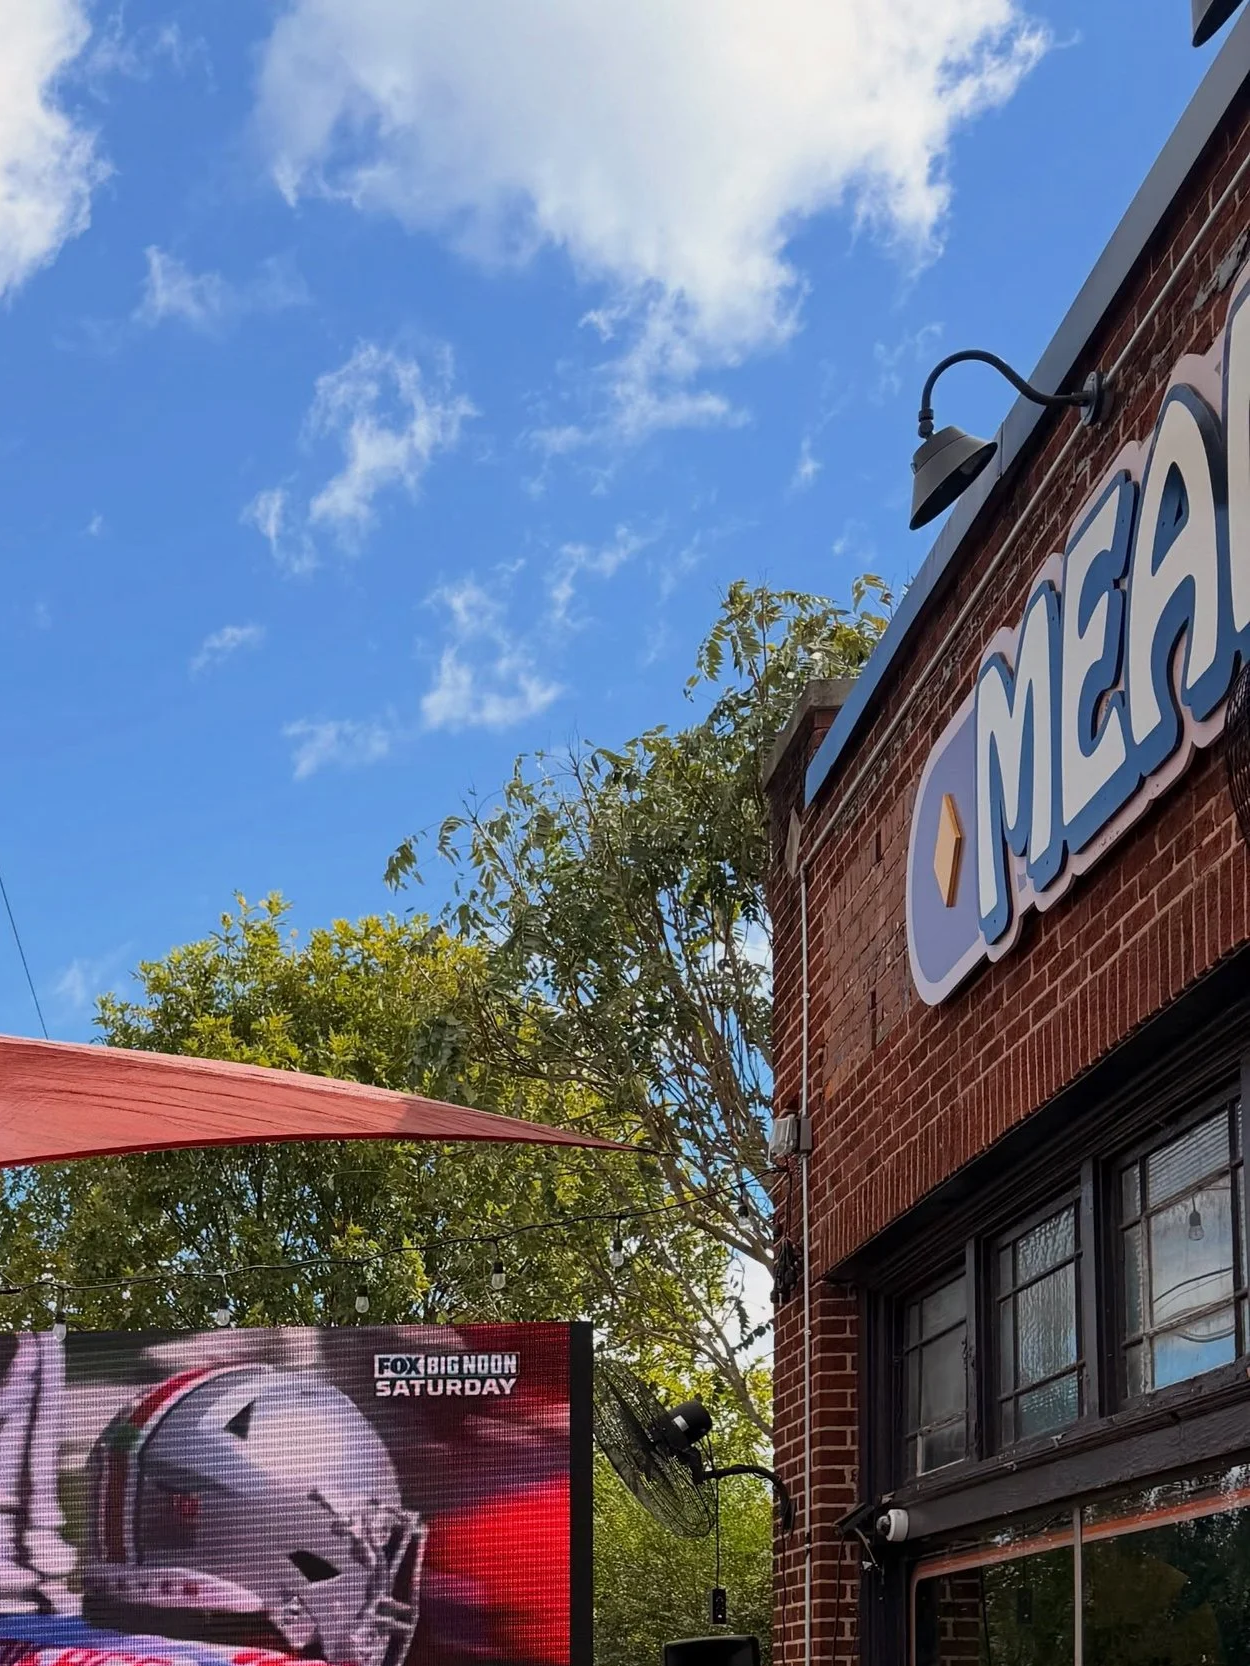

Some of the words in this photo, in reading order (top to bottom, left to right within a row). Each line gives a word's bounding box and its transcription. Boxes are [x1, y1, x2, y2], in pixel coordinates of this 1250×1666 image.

[974, 280, 1250, 945] MEA
[377, 1356, 422, 1375] FOX
[427, 1355, 459, 1375] BIG
[463, 1354, 517, 1374] NOON
[375, 1378, 517, 1396] SATURDAY
